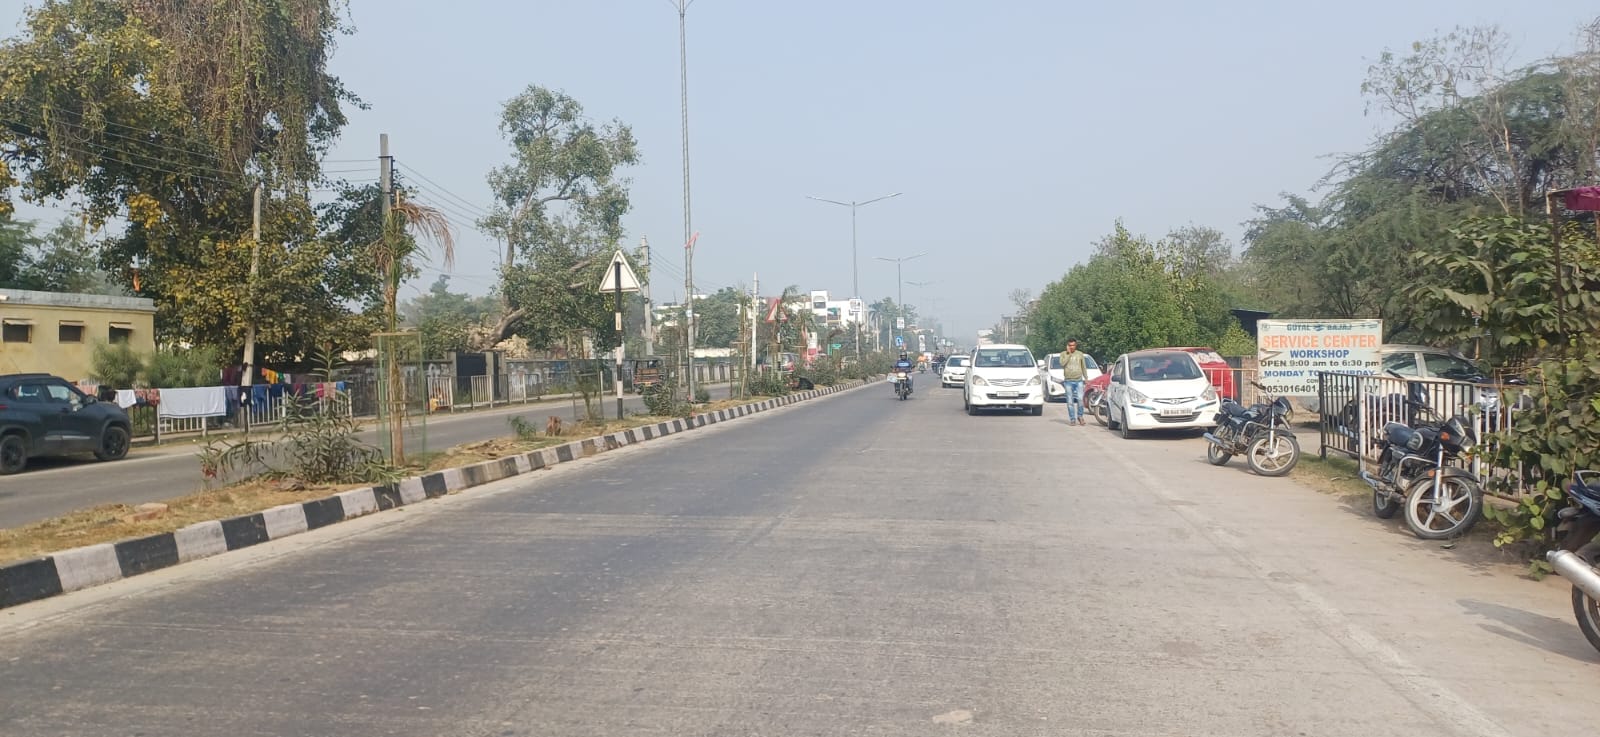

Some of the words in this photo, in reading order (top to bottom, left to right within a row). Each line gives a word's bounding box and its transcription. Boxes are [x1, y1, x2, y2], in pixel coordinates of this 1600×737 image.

[1263, 335, 1318, 348] SERVICE
[1323, 335, 1376, 348] CENTER
[1290, 350, 1349, 358] WORKSHOP
